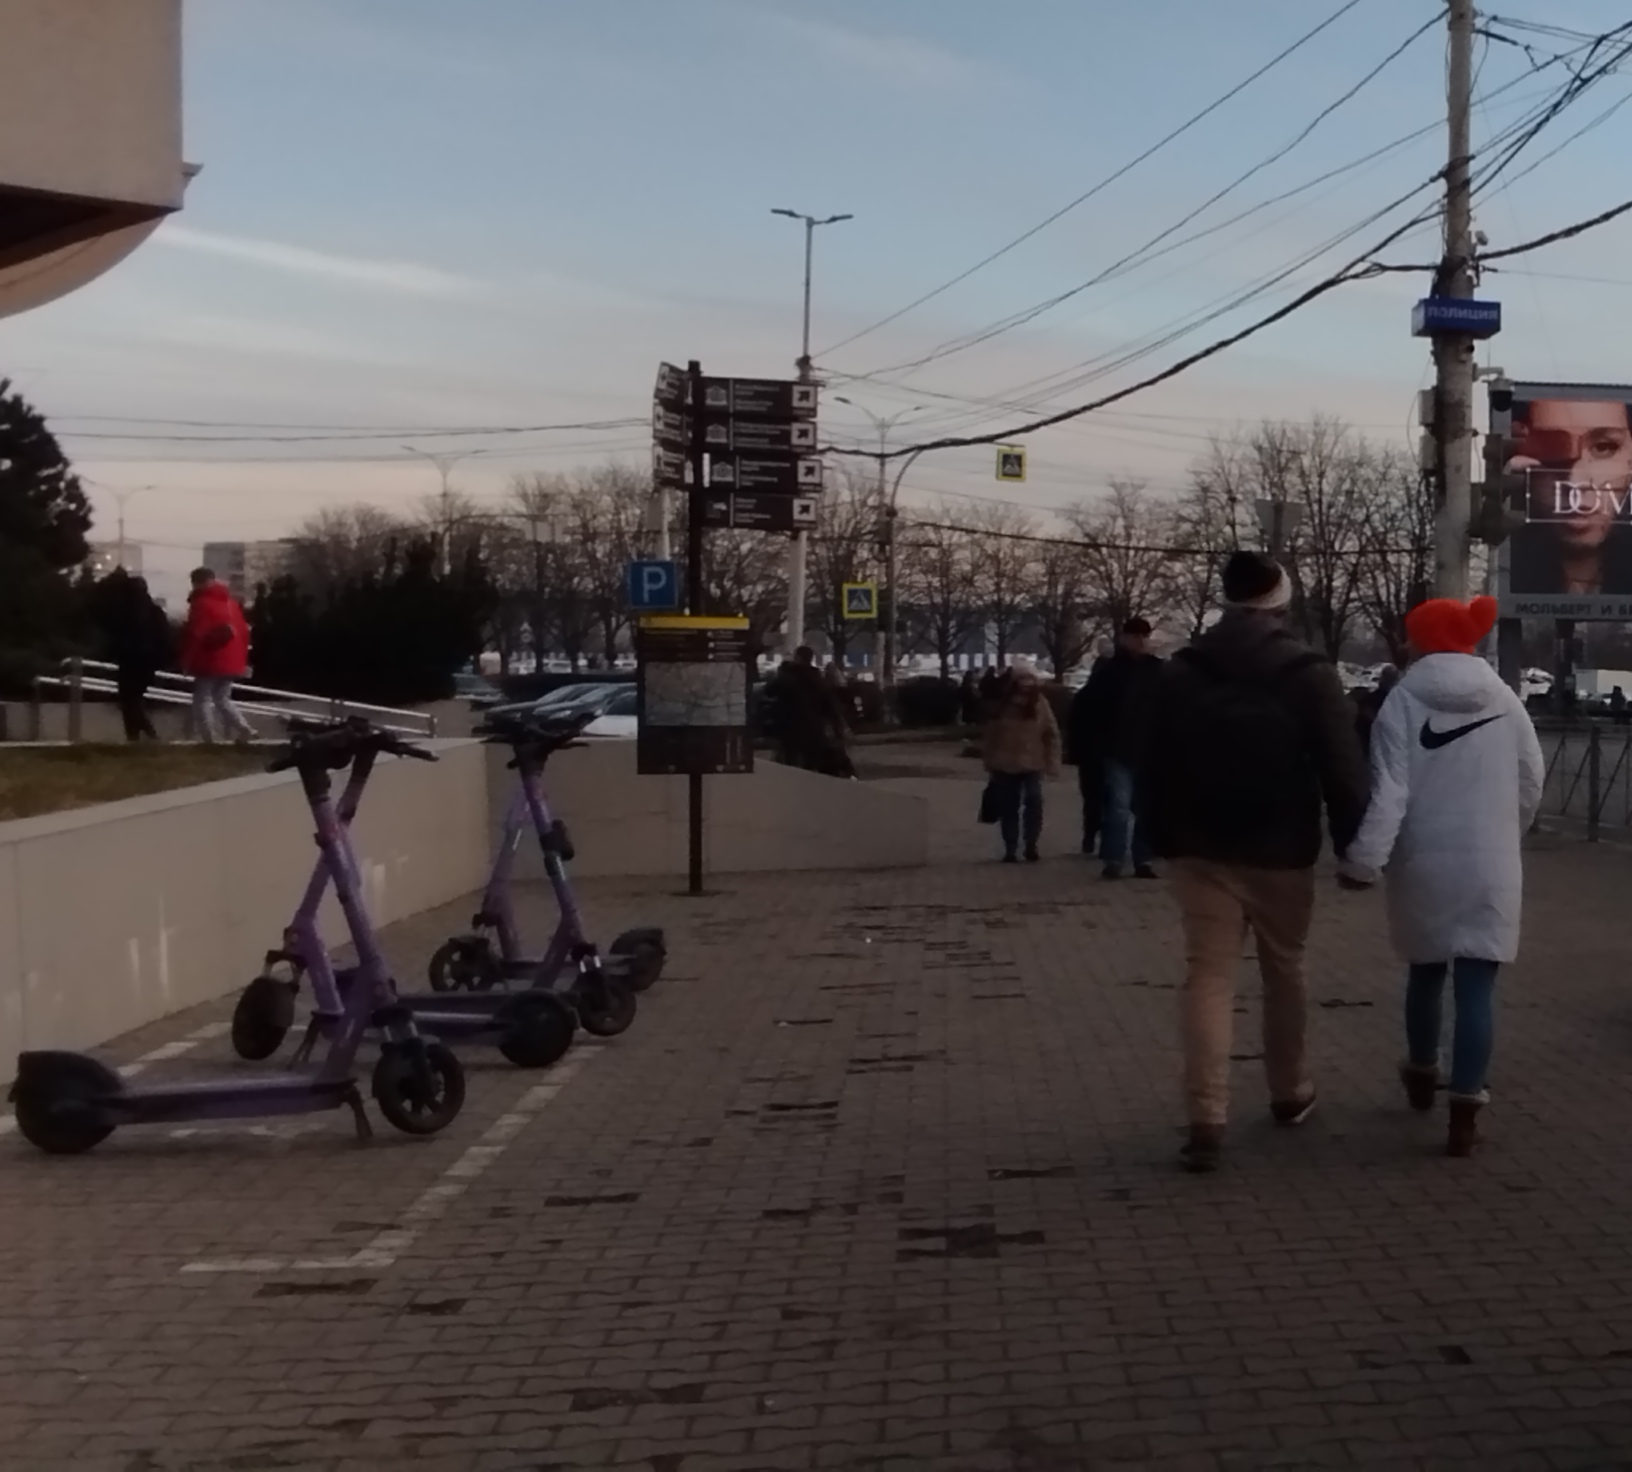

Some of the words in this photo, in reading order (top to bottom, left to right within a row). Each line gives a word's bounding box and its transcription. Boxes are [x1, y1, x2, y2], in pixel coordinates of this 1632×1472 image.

[1427, 306, 1498, 320] ПОЛИЦИЯ
[1515, 602, 1592, 616] МОЛЬБЕРТ
[1601, 604, 1612, 616] И
